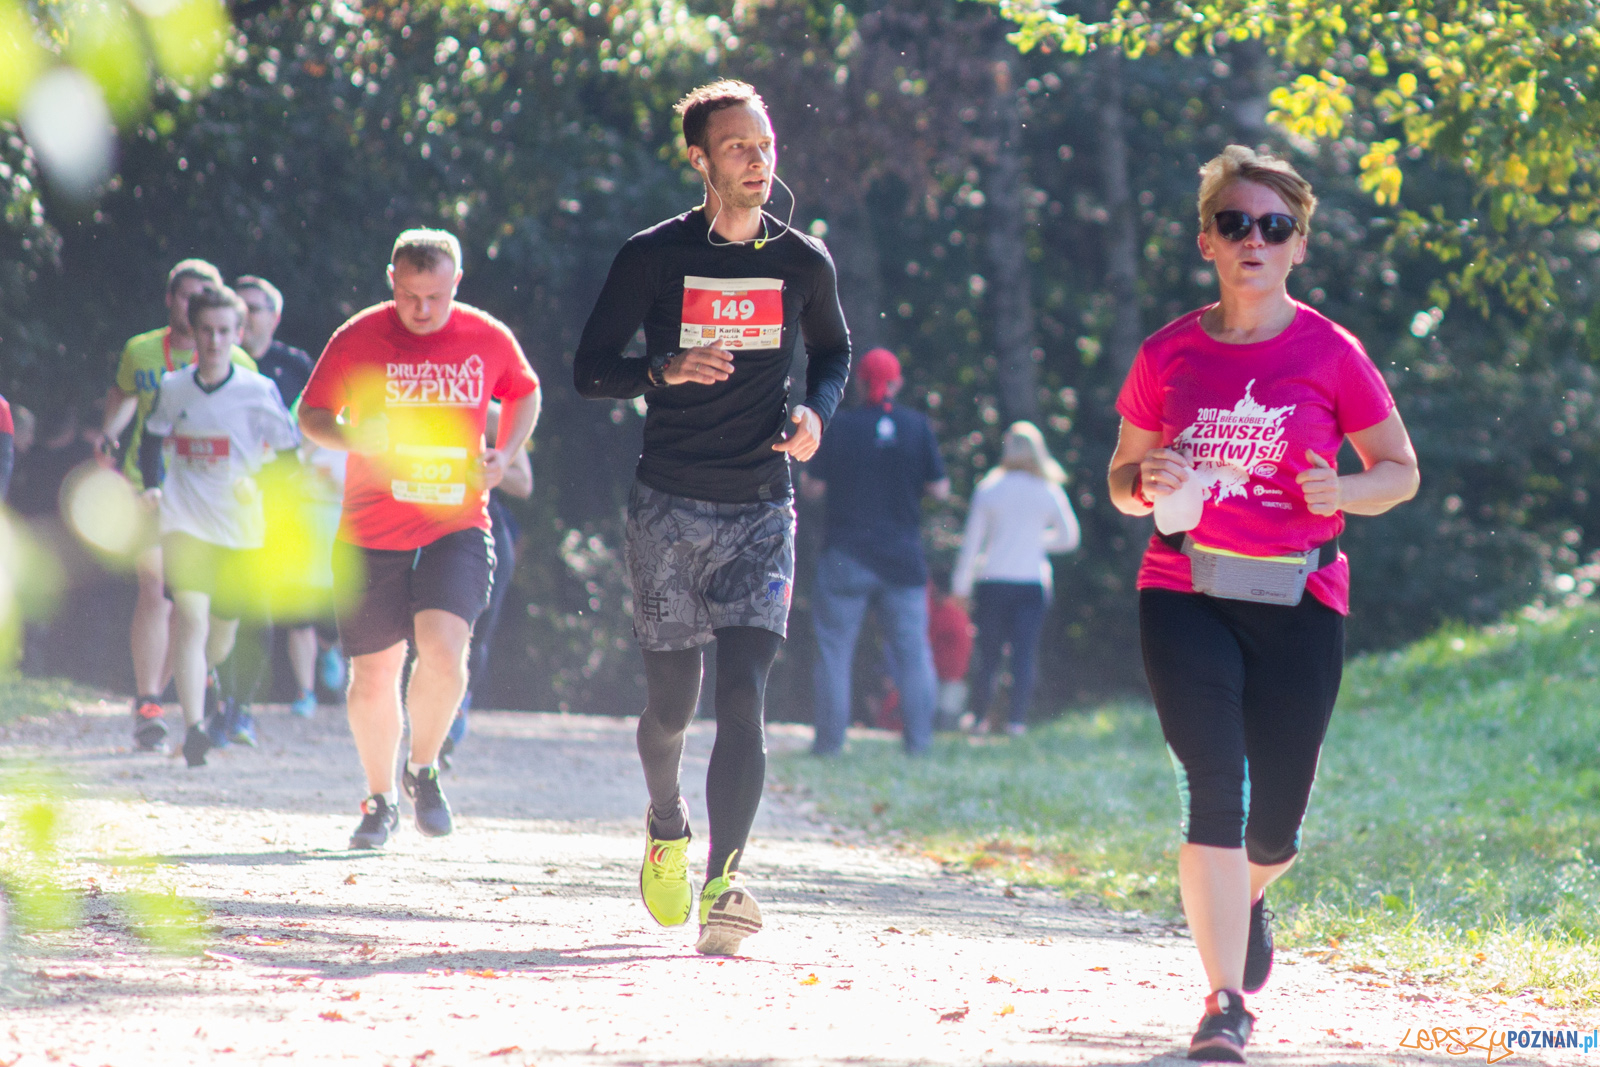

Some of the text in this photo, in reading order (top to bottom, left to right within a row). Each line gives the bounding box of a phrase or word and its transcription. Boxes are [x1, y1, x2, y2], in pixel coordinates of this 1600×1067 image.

[711, 299, 755, 320] 149
[386, 360, 470, 379] DRUŻYNA
[385, 377, 484, 403] SZPIKU
[1197, 408, 1267, 425] 2017 BIEG KOBIET
[1191, 423, 1277, 441] zawsze
[411, 462, 452, 481] 209
